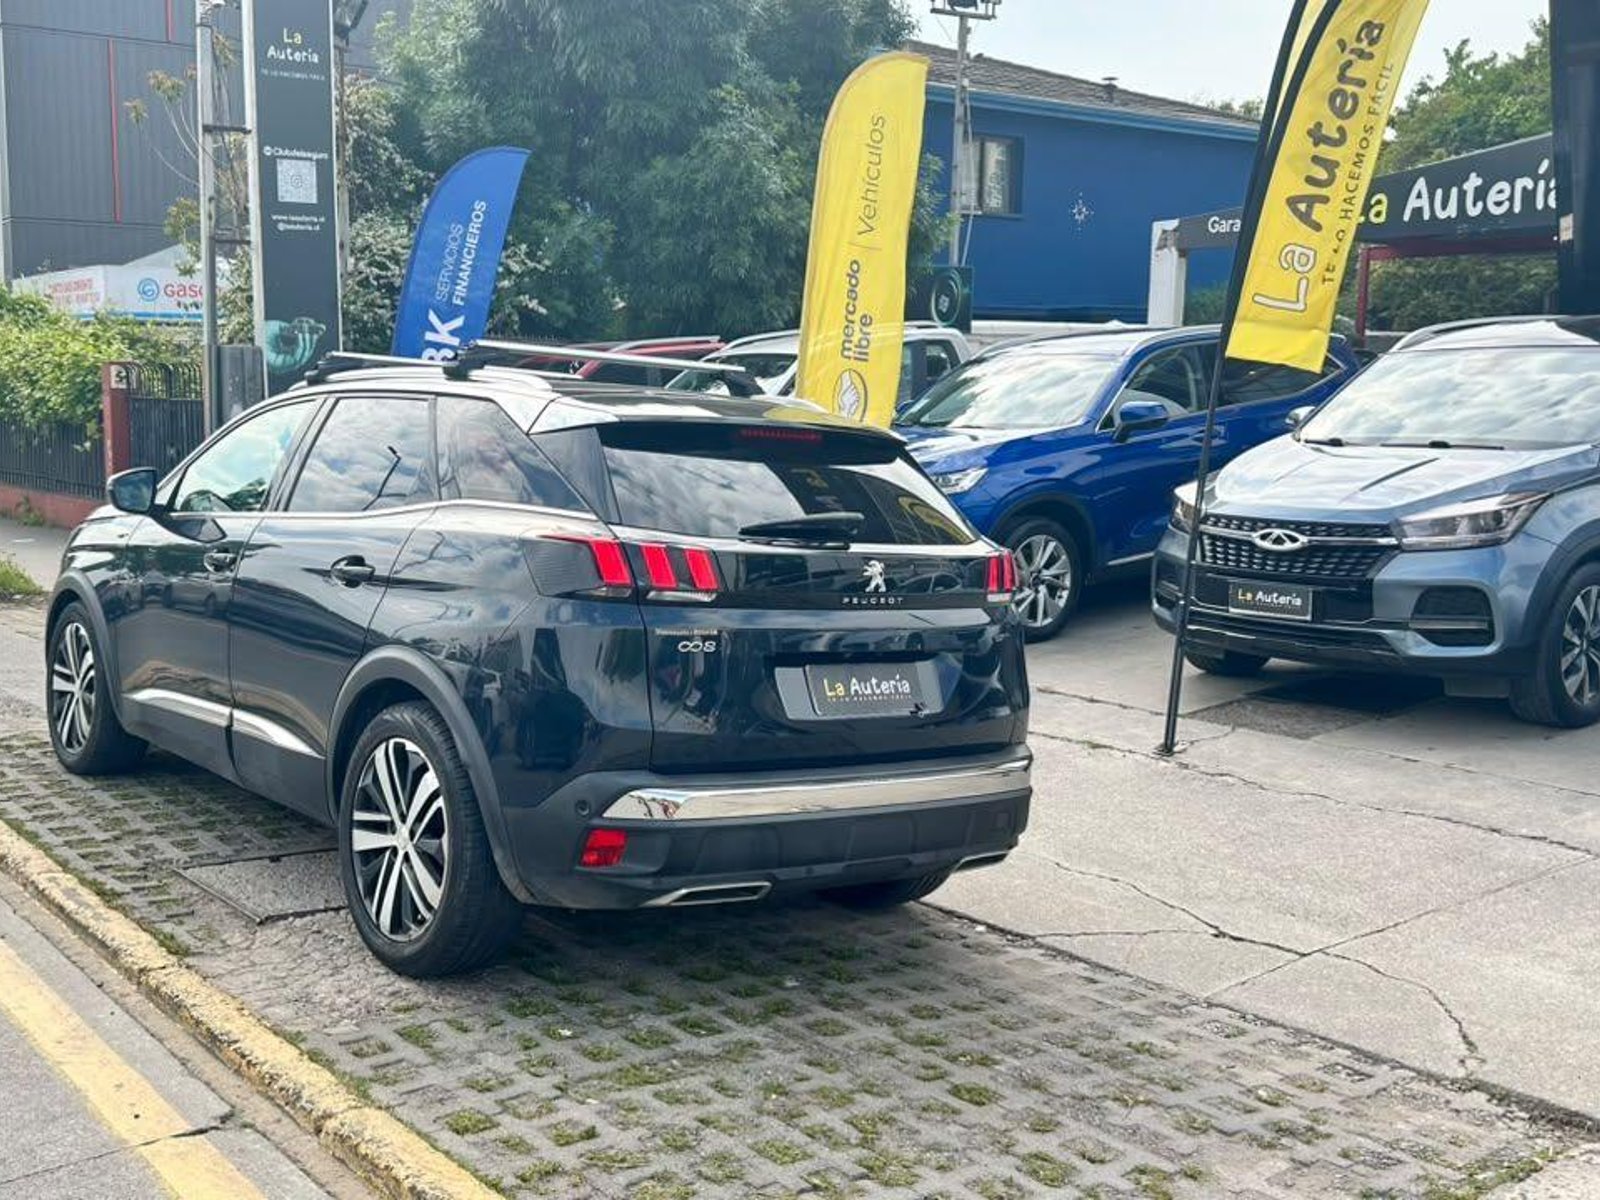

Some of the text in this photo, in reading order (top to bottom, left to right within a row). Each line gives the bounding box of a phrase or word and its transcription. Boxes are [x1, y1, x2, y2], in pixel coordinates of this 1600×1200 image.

[283, 27, 302, 44] La
[857, 114, 886, 236] Vehículos
[1252, 18, 1386, 312] La Autería
[1338, 124, 1375, 220] HACEMOS
[436, 223, 464, 302] SERVICIOS
[452, 199, 487, 306] FINANCIEROS
[840, 258, 862, 360] mercado
[853, 313, 873, 363] libre
[842, 596, 904, 605] PEUGEOT
[823, 673, 911, 696] La Autería
